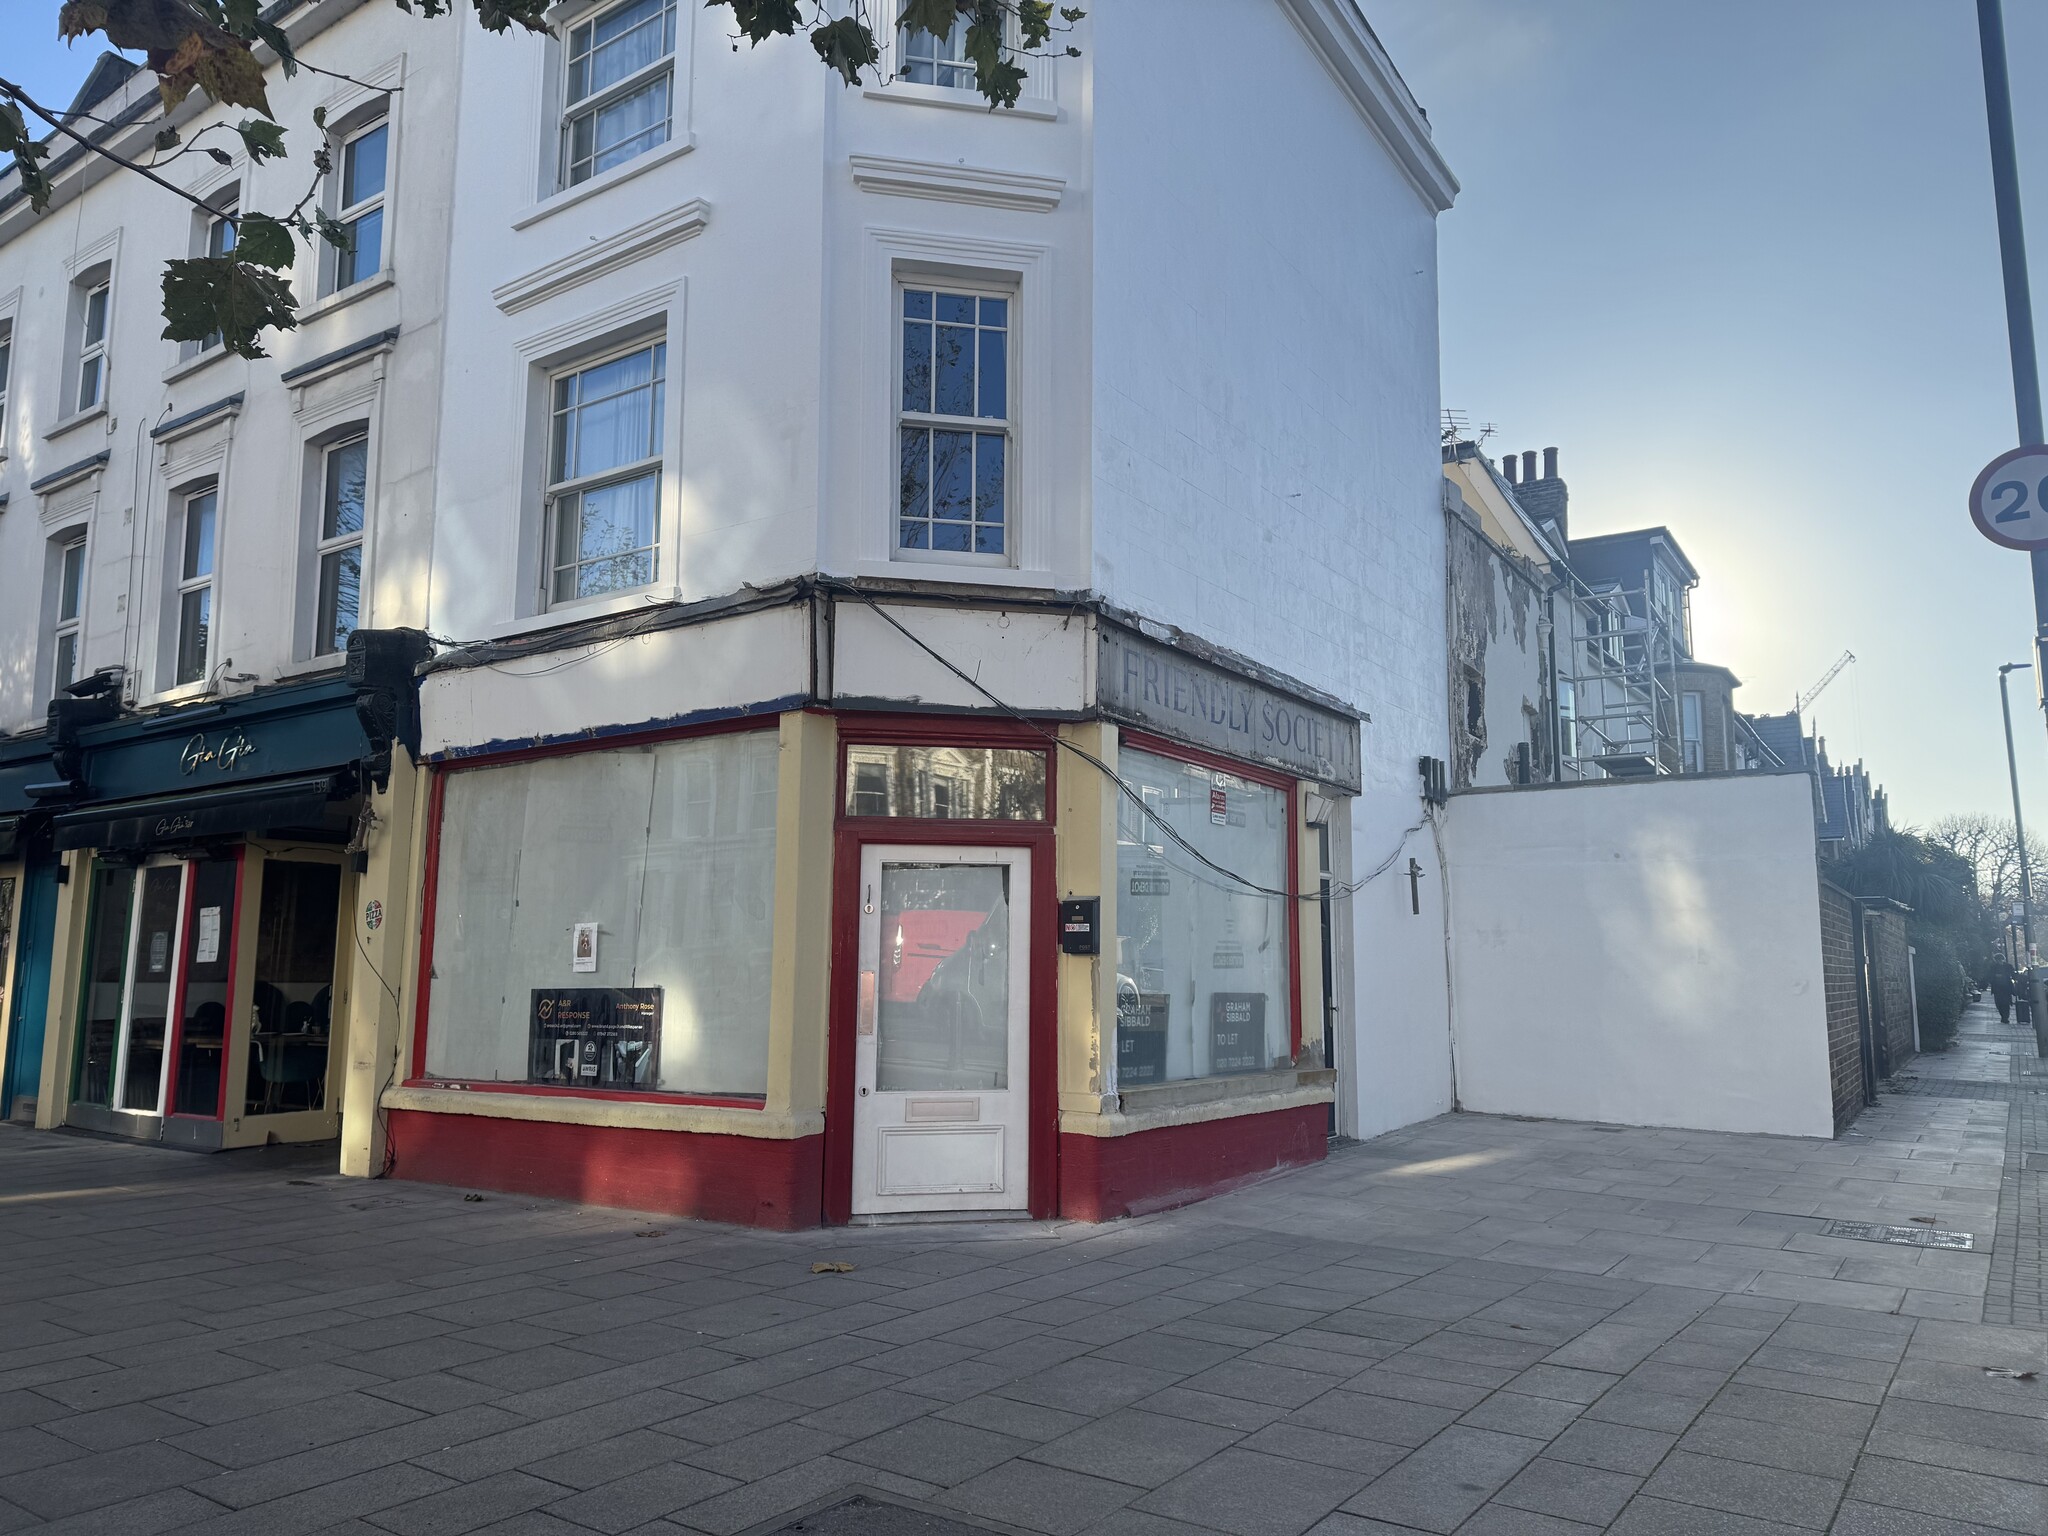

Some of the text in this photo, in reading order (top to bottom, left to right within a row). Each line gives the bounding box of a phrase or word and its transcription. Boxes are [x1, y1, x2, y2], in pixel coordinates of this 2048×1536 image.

[1991, 474, 2048, 524] 2
[1123, 650, 1349, 765] FRIENDLY SOCIETY
[366, 909, 382, 921] PIZZA
[616, 1003, 639, 1011] Anthony
[1120, 1004, 1150, 1016] GRAHAM
[1226, 1002, 1250, 1012] GRAHAM
[557, 1011, 590, 1019] RESPONSE
[1226, 1012, 1250, 1022] SIBBALD
[1120, 1016, 1150, 1027] SIBBALD
[1217, 1033, 1238, 1046] TO LET
[1121, 1040, 1134, 1053] LET
[1216, 1056, 1255, 1068] 020 7224 2222
[1122, 1066, 1138, 1078] 7224
